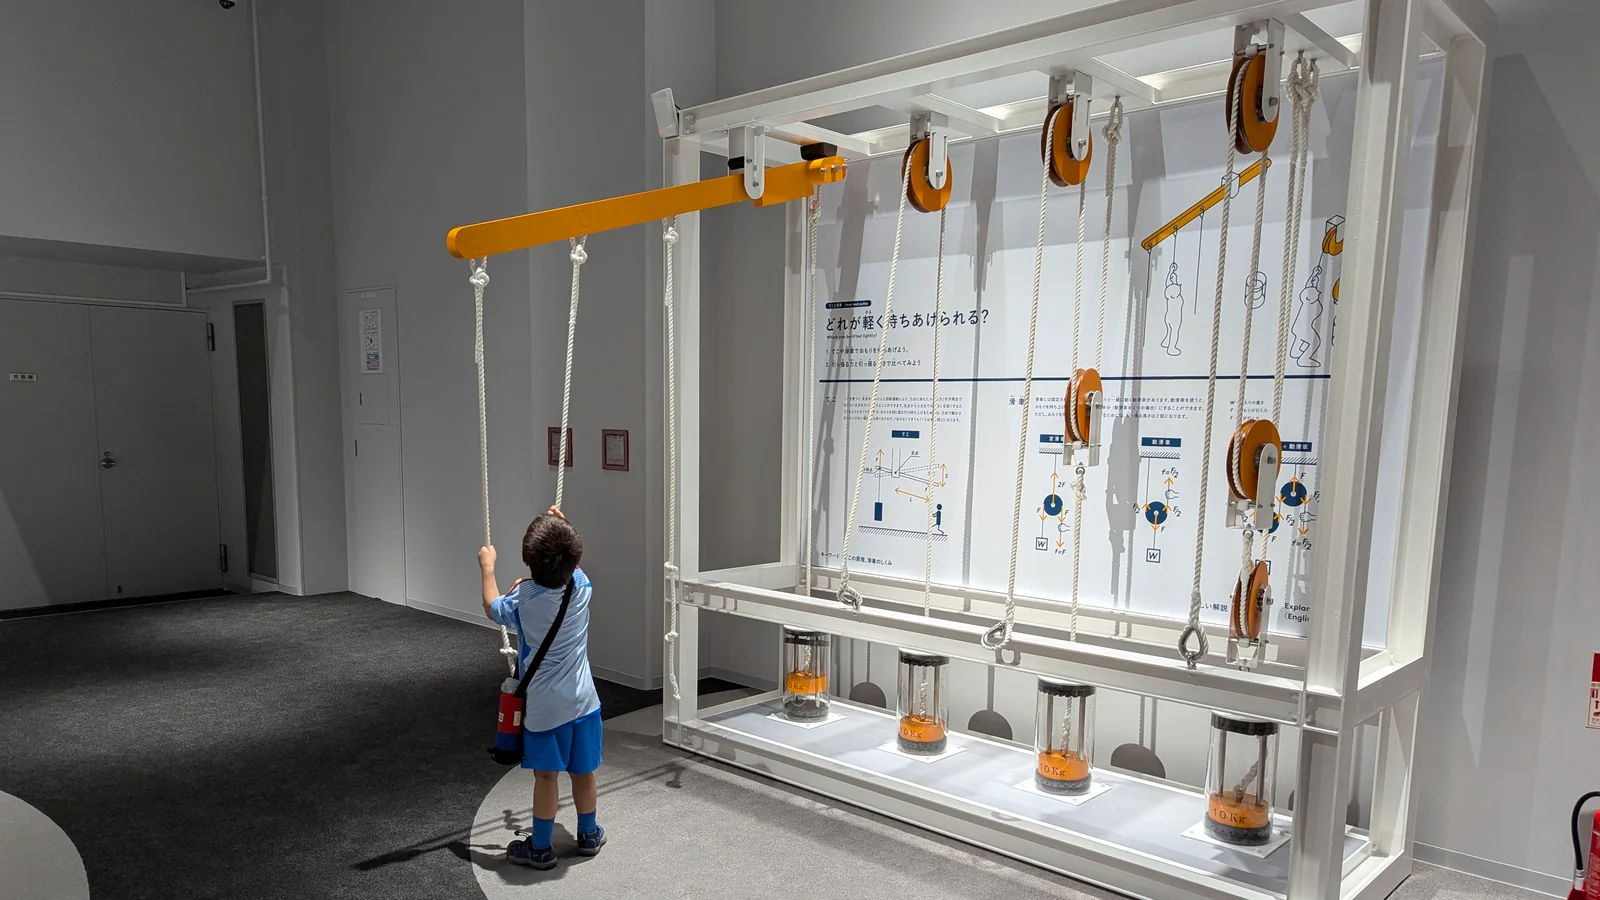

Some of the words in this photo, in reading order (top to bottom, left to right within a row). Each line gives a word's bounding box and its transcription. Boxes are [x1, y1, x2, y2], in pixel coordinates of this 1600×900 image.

[1271, 535, 1277, 543] F
[1037, 540, 1046, 548] W
[1148, 551, 1159, 560] W
